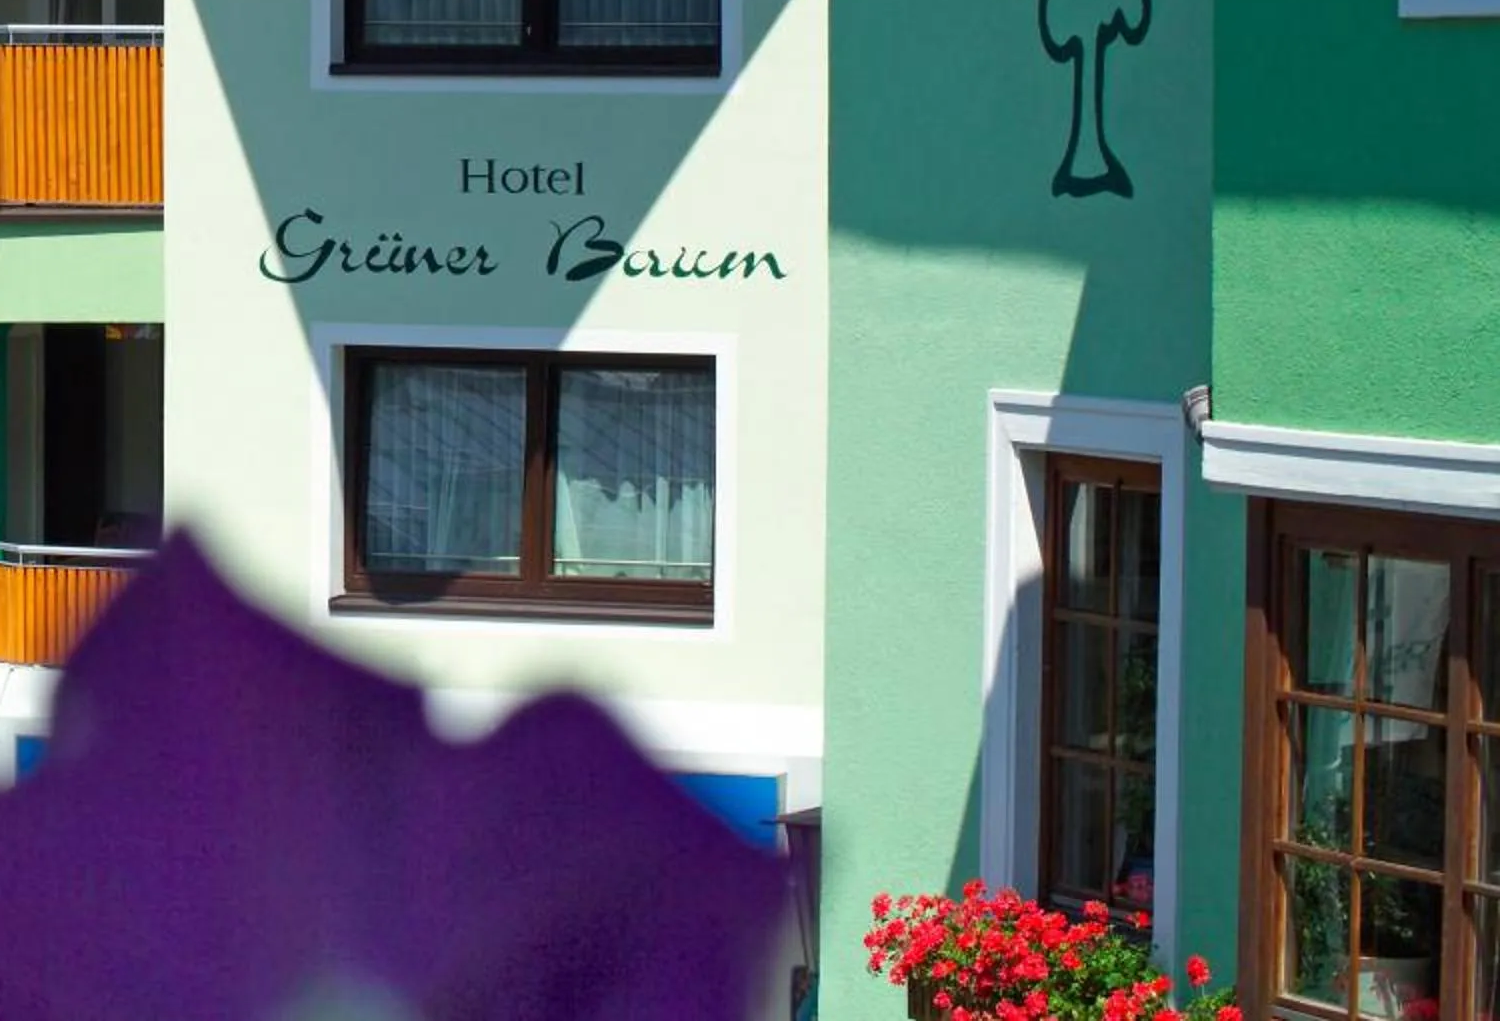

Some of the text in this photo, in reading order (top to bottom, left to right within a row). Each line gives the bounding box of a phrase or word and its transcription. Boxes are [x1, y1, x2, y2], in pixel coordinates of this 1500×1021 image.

[460, 158, 585, 196] Hotel
[259, 208, 787, 284] Grüner Baum
